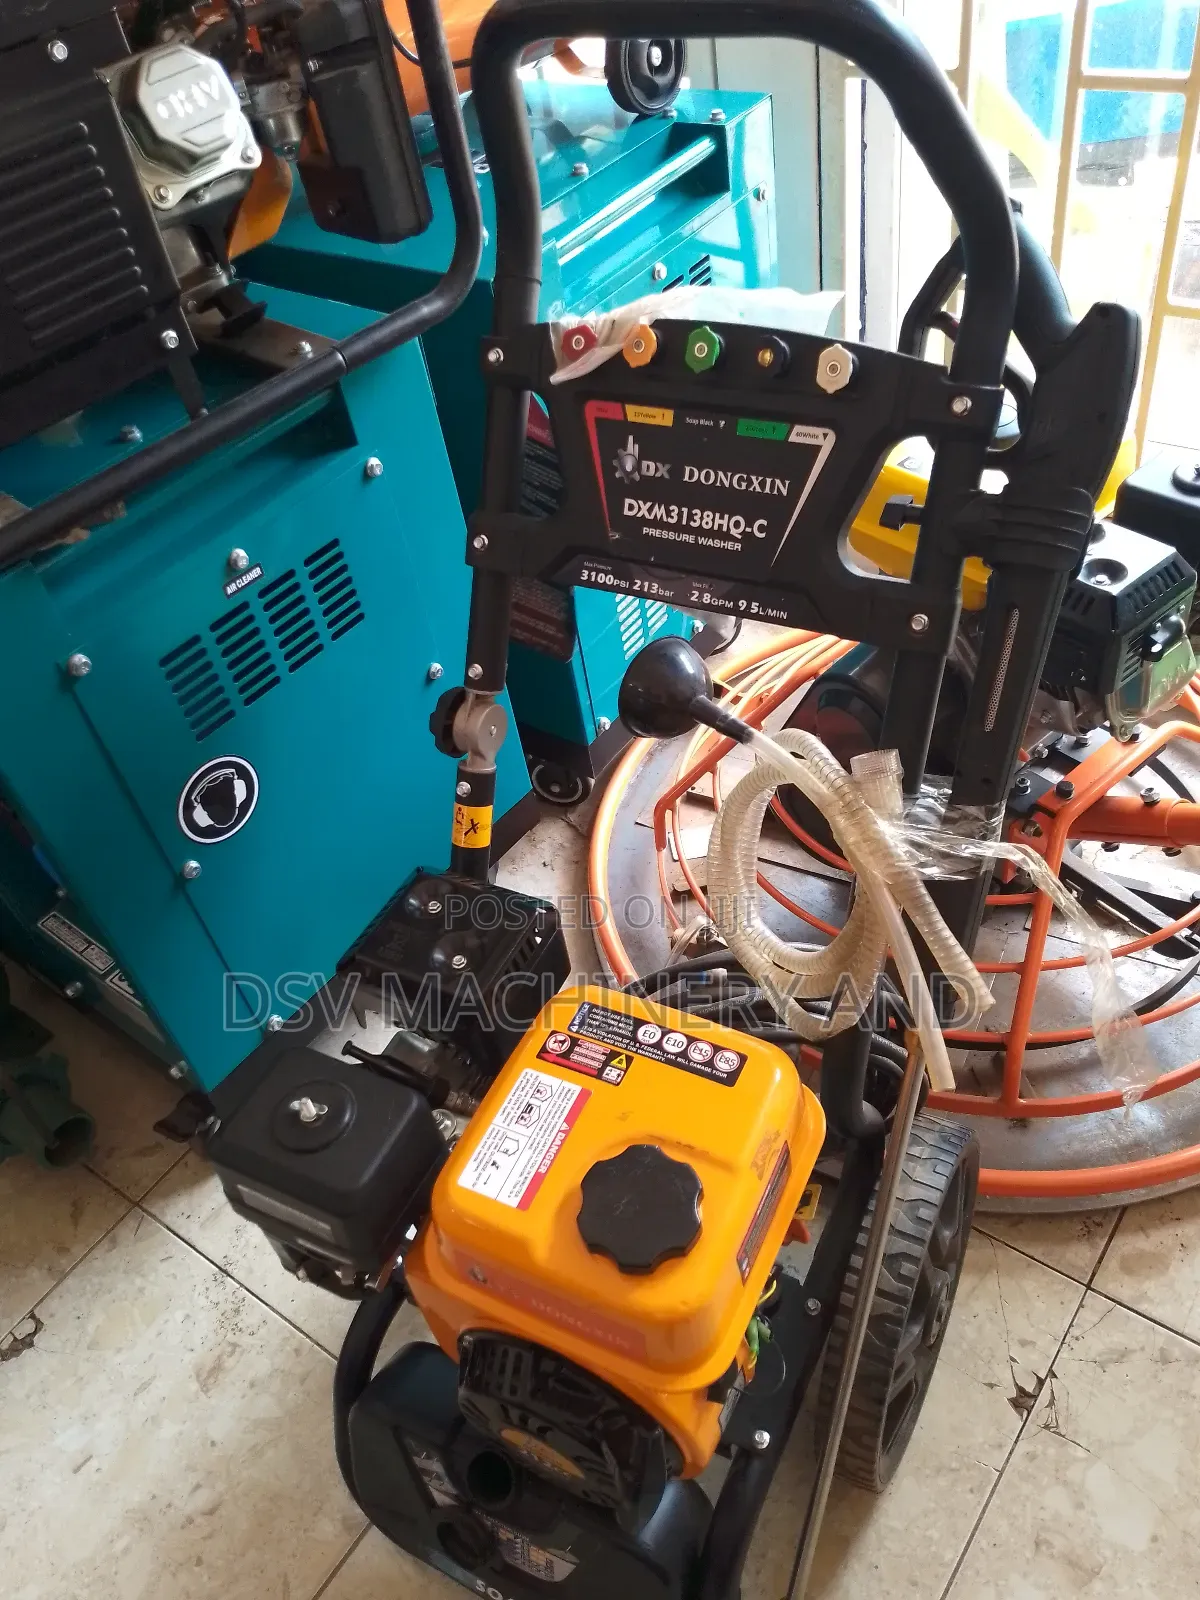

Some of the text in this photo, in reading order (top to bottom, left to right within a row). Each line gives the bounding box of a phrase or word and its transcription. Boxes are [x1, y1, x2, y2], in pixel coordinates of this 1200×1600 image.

[795, 431, 819, 440] 40White
[641, 460, 672, 479] DX
[683, 465, 790, 497] DONGXIN
[623, 498, 768, 539] DXM3138HQ-C
[642, 527, 742, 551] PRESSURE WASHER
[226, 566, 262, 595] AIR CLEANER
[580, 569, 675, 597] 3100PSI 213bar
[642, 1029, 656, 1040] E0
[665, 1036, 684, 1049] E10
[718, 1055, 736, 1067] E85
[537, 1130, 566, 1175] DANGER
[475, 1579, 514, 1600] SO
